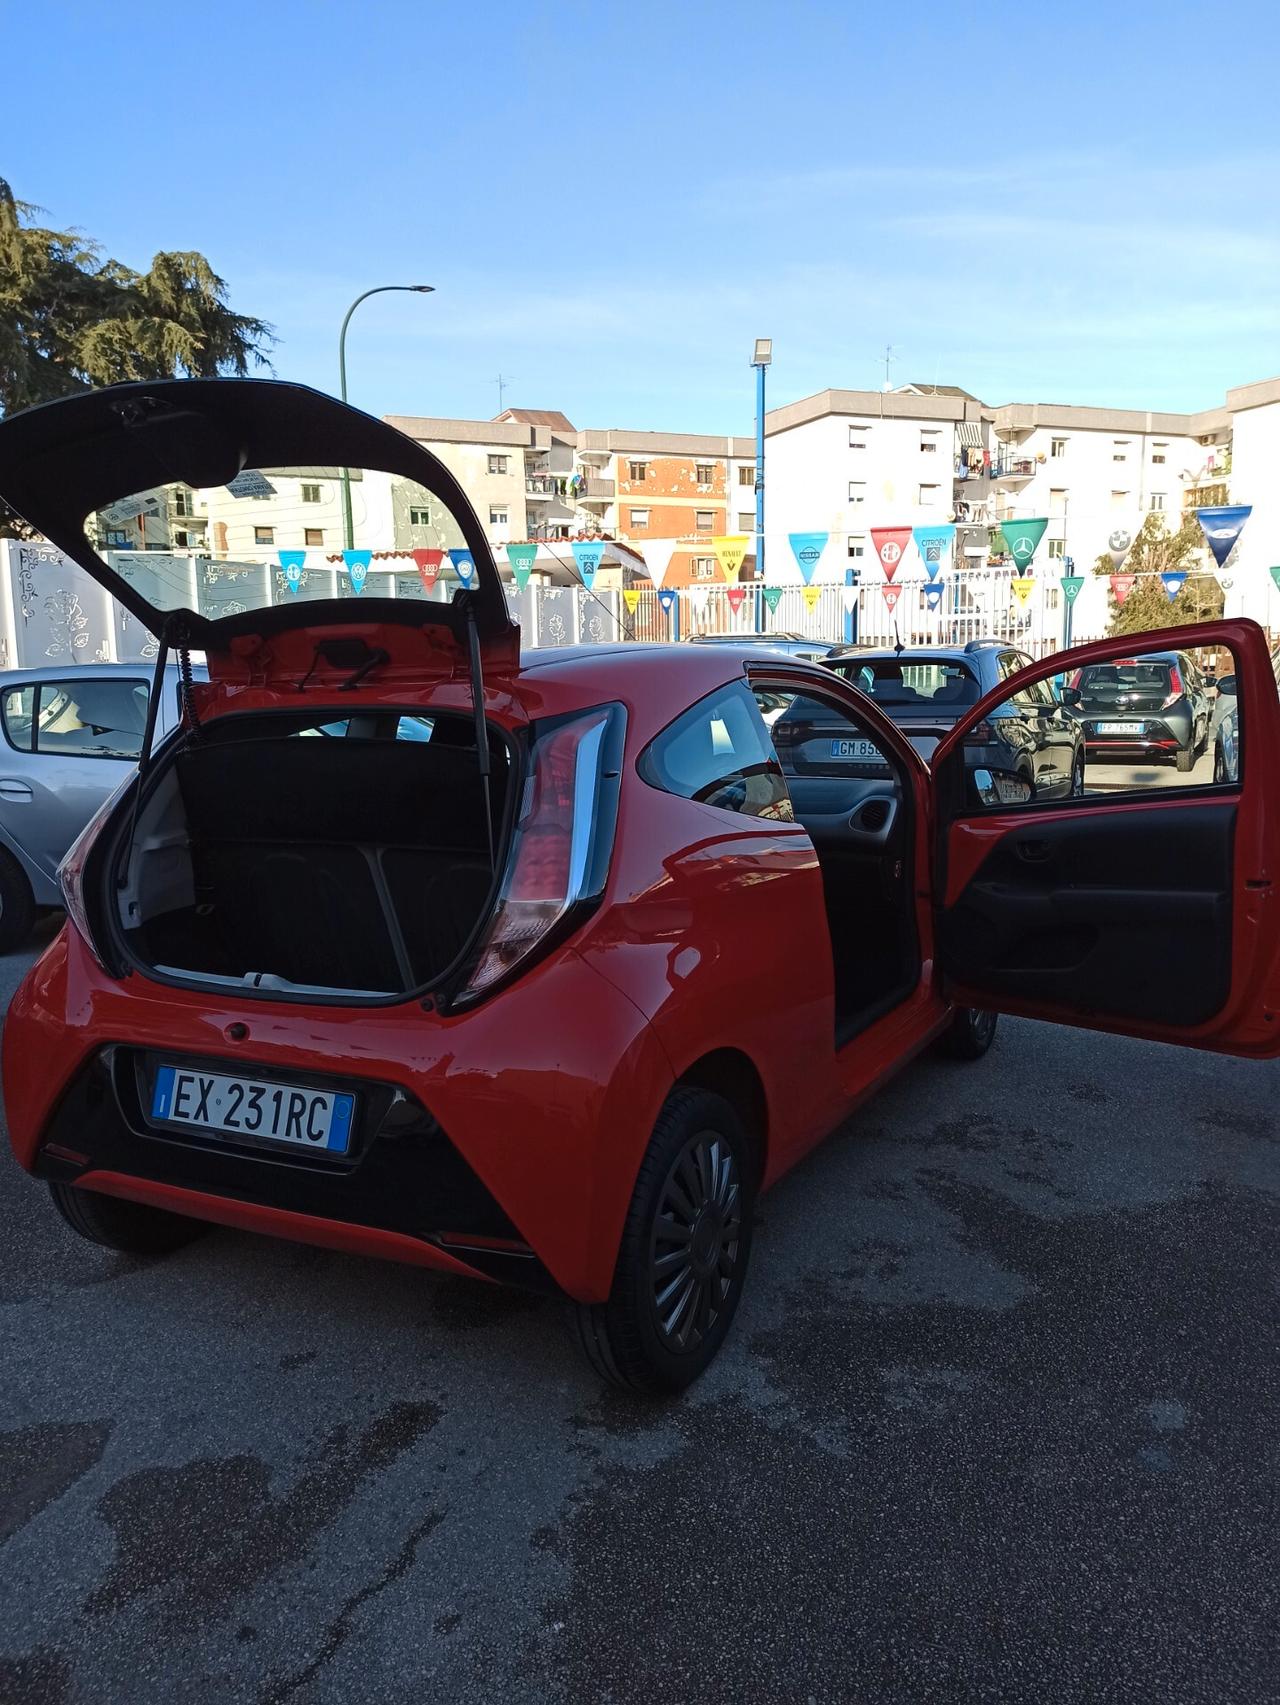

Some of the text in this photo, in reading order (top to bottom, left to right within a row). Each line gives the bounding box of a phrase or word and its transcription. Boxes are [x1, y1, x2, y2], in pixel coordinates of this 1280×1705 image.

[840, 742, 855, 754] GM
[174, 1075, 328, 1142] EX 231RC
